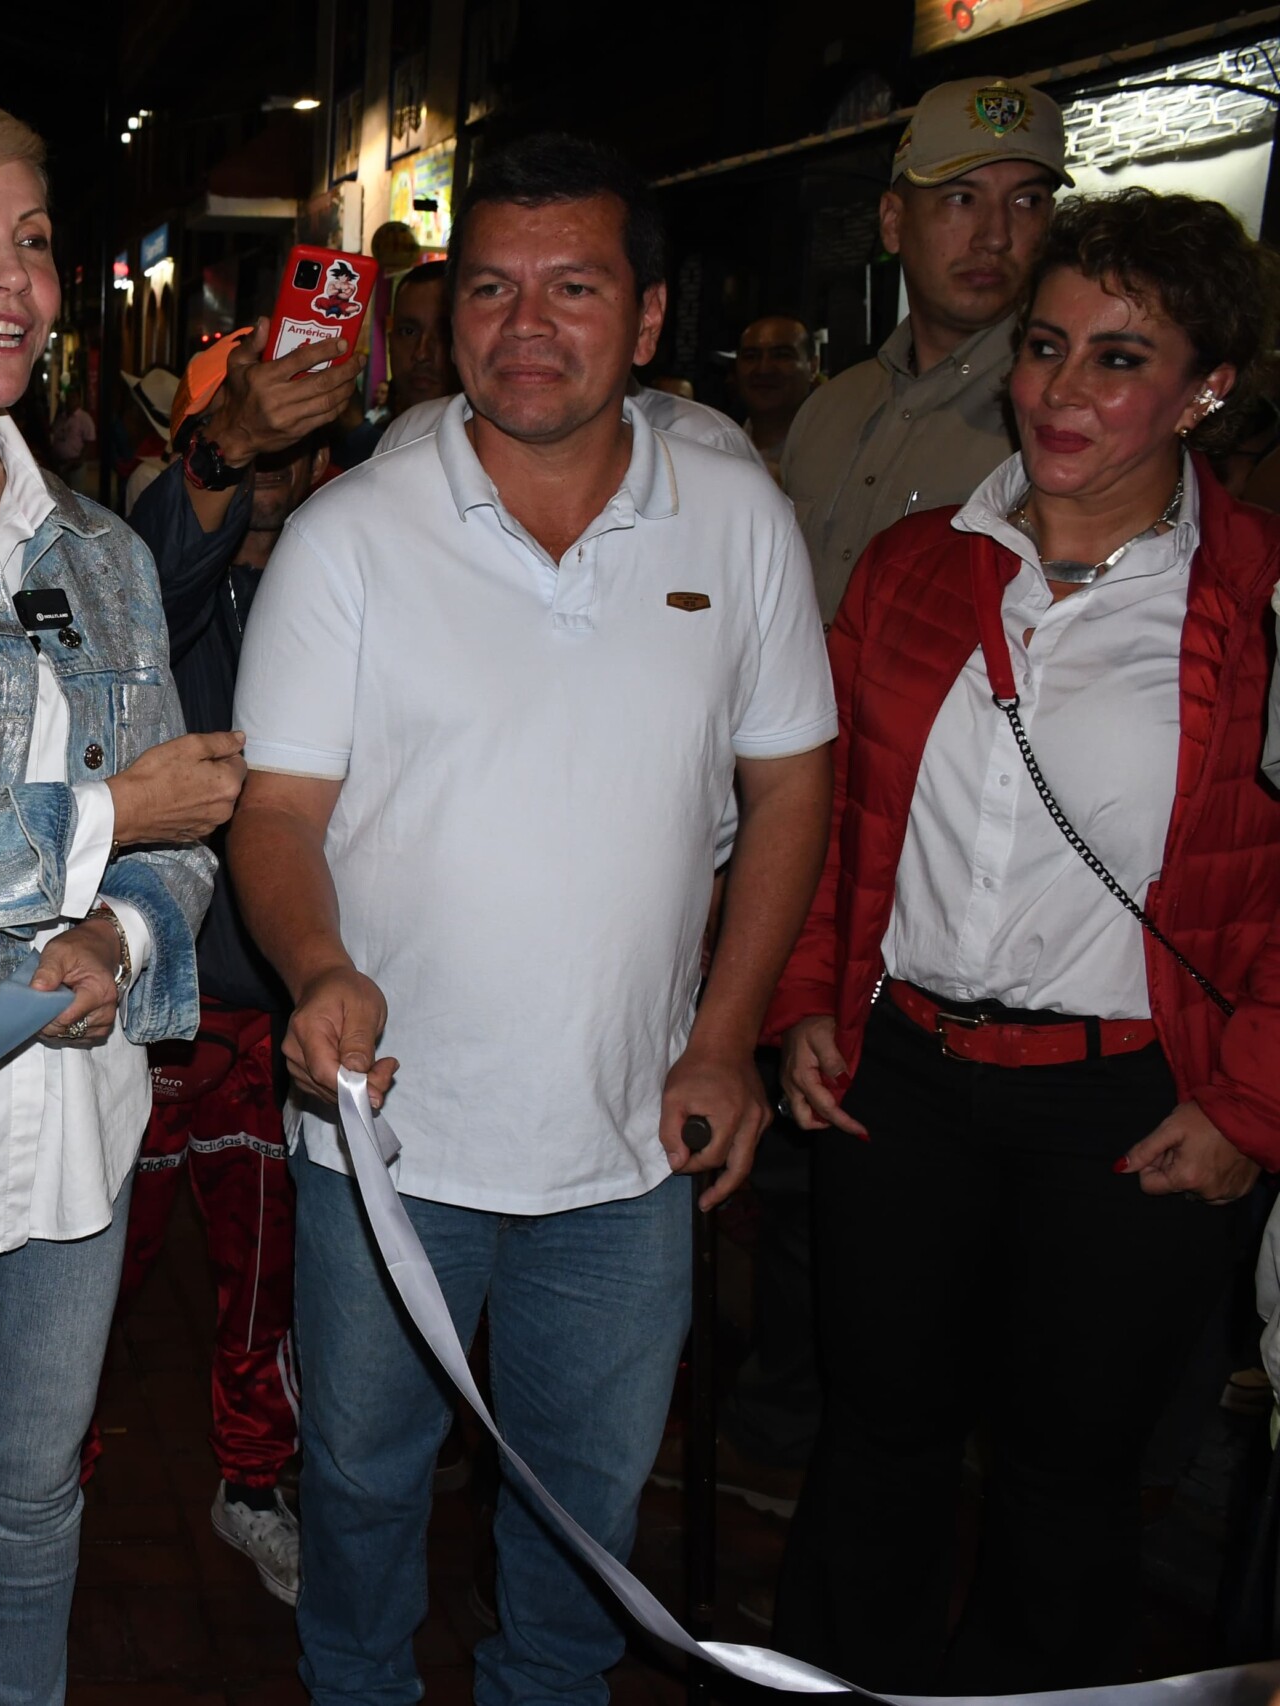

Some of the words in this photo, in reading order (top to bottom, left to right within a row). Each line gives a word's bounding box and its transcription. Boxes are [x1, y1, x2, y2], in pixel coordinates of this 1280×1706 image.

[287, 325, 332, 339] América
[194, 1136, 241, 1152] adidas
[252, 1140, 288, 1158] adida
